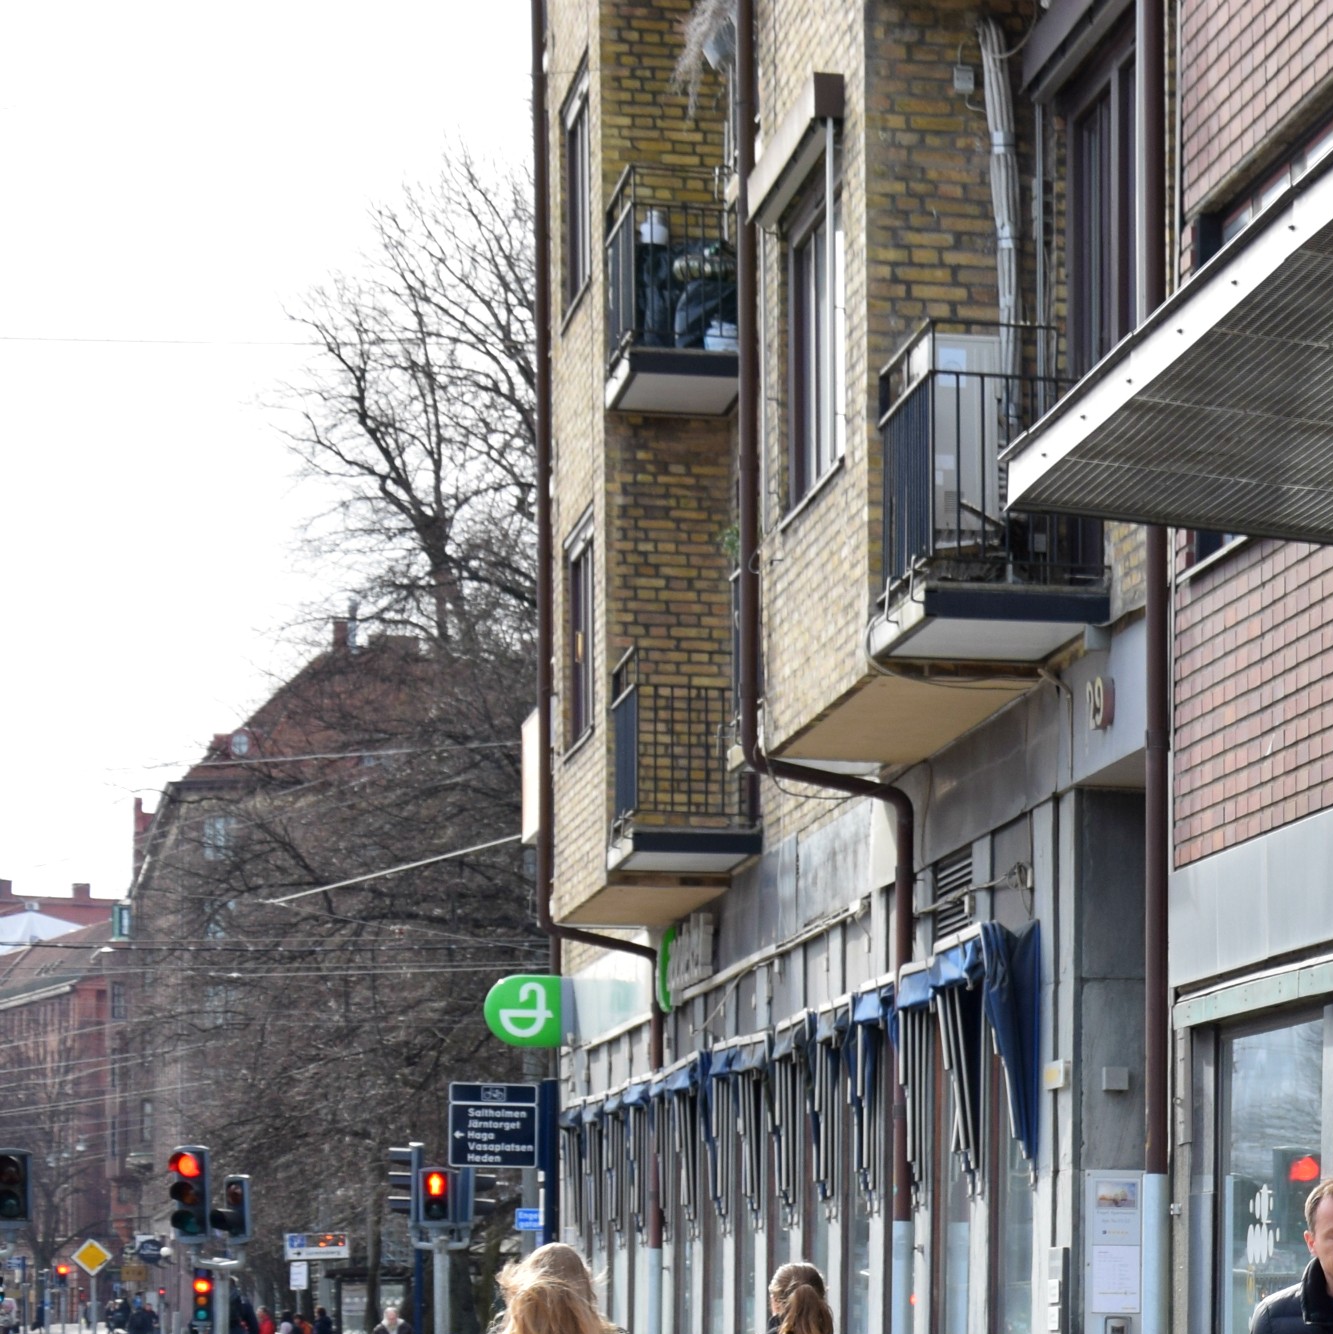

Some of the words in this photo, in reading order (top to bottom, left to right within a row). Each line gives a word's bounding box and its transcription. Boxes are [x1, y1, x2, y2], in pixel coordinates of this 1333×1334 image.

[467, 1108, 527, 1118] Saltholmen
[467, 1120, 521, 1131] Järntorget
[467, 1131, 495, 1141] Haga
[467, 1142, 534, 1152] Vasaplatsen
[467, 1154, 501, 1162] Heden
